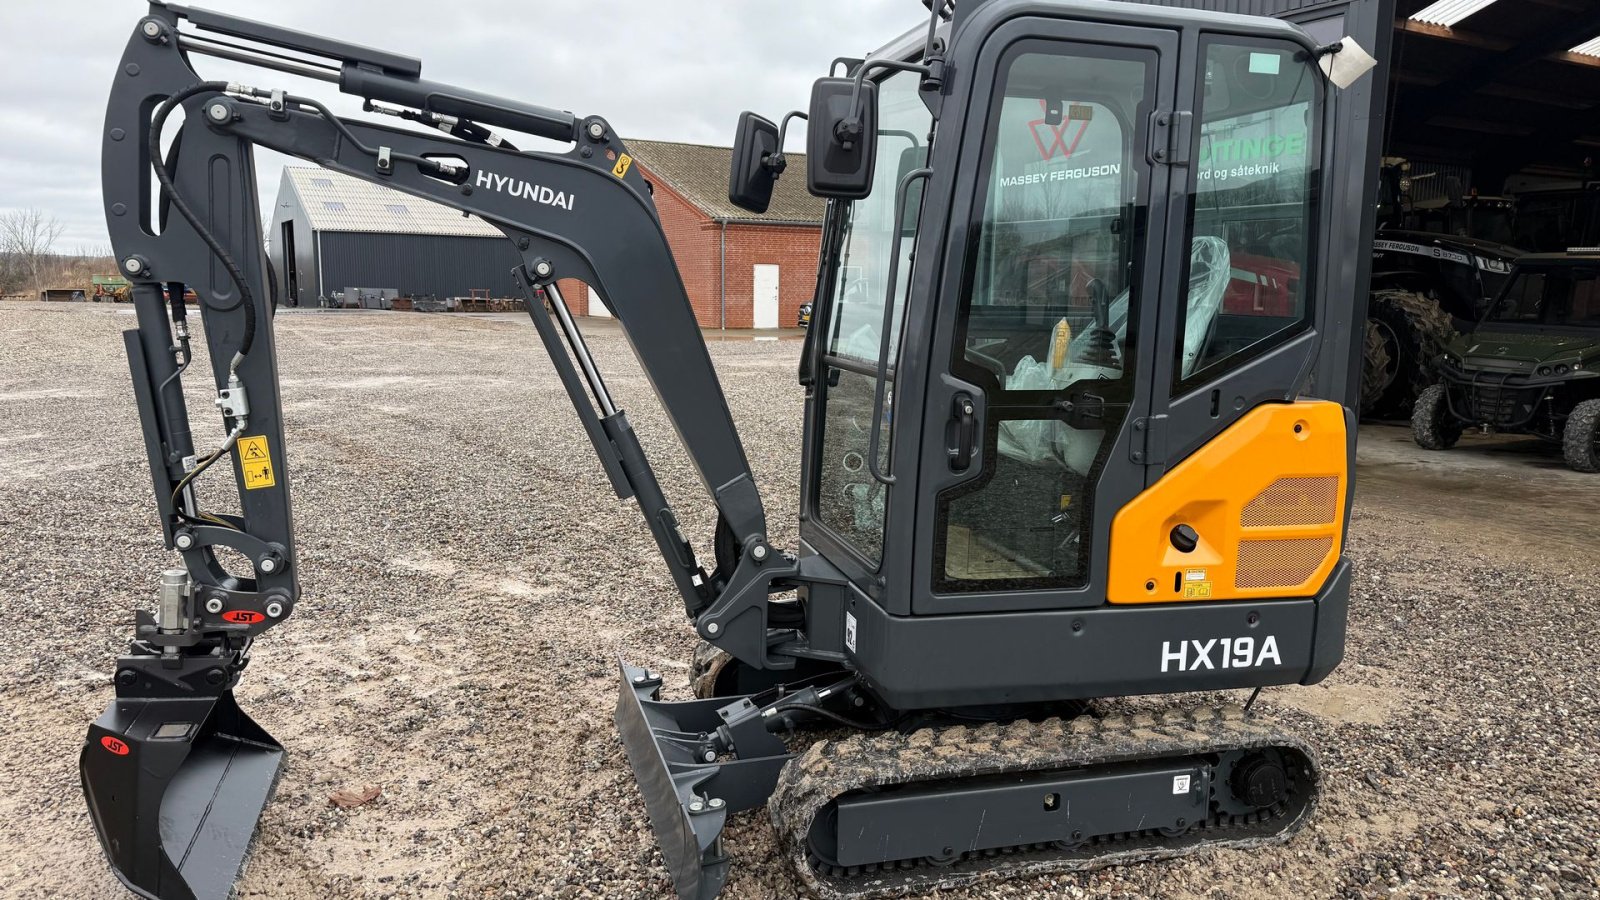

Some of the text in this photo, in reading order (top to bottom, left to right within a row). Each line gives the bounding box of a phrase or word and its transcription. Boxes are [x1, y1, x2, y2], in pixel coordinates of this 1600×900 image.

[1000, 163, 1121, 187] MASSEY FERGUSON
[1213, 169, 1228, 181] og
[1230, 162, 1280, 177] såteknik
[475, 169, 575, 211] HYUNDAI
[1389, 243, 1420, 253] FERGUSON
[1433, 248, 1441, 257] S
[232, 612, 256, 622] JST
[1160, 635, 1282, 673] HX19A
[107, 739, 124, 753] JST
